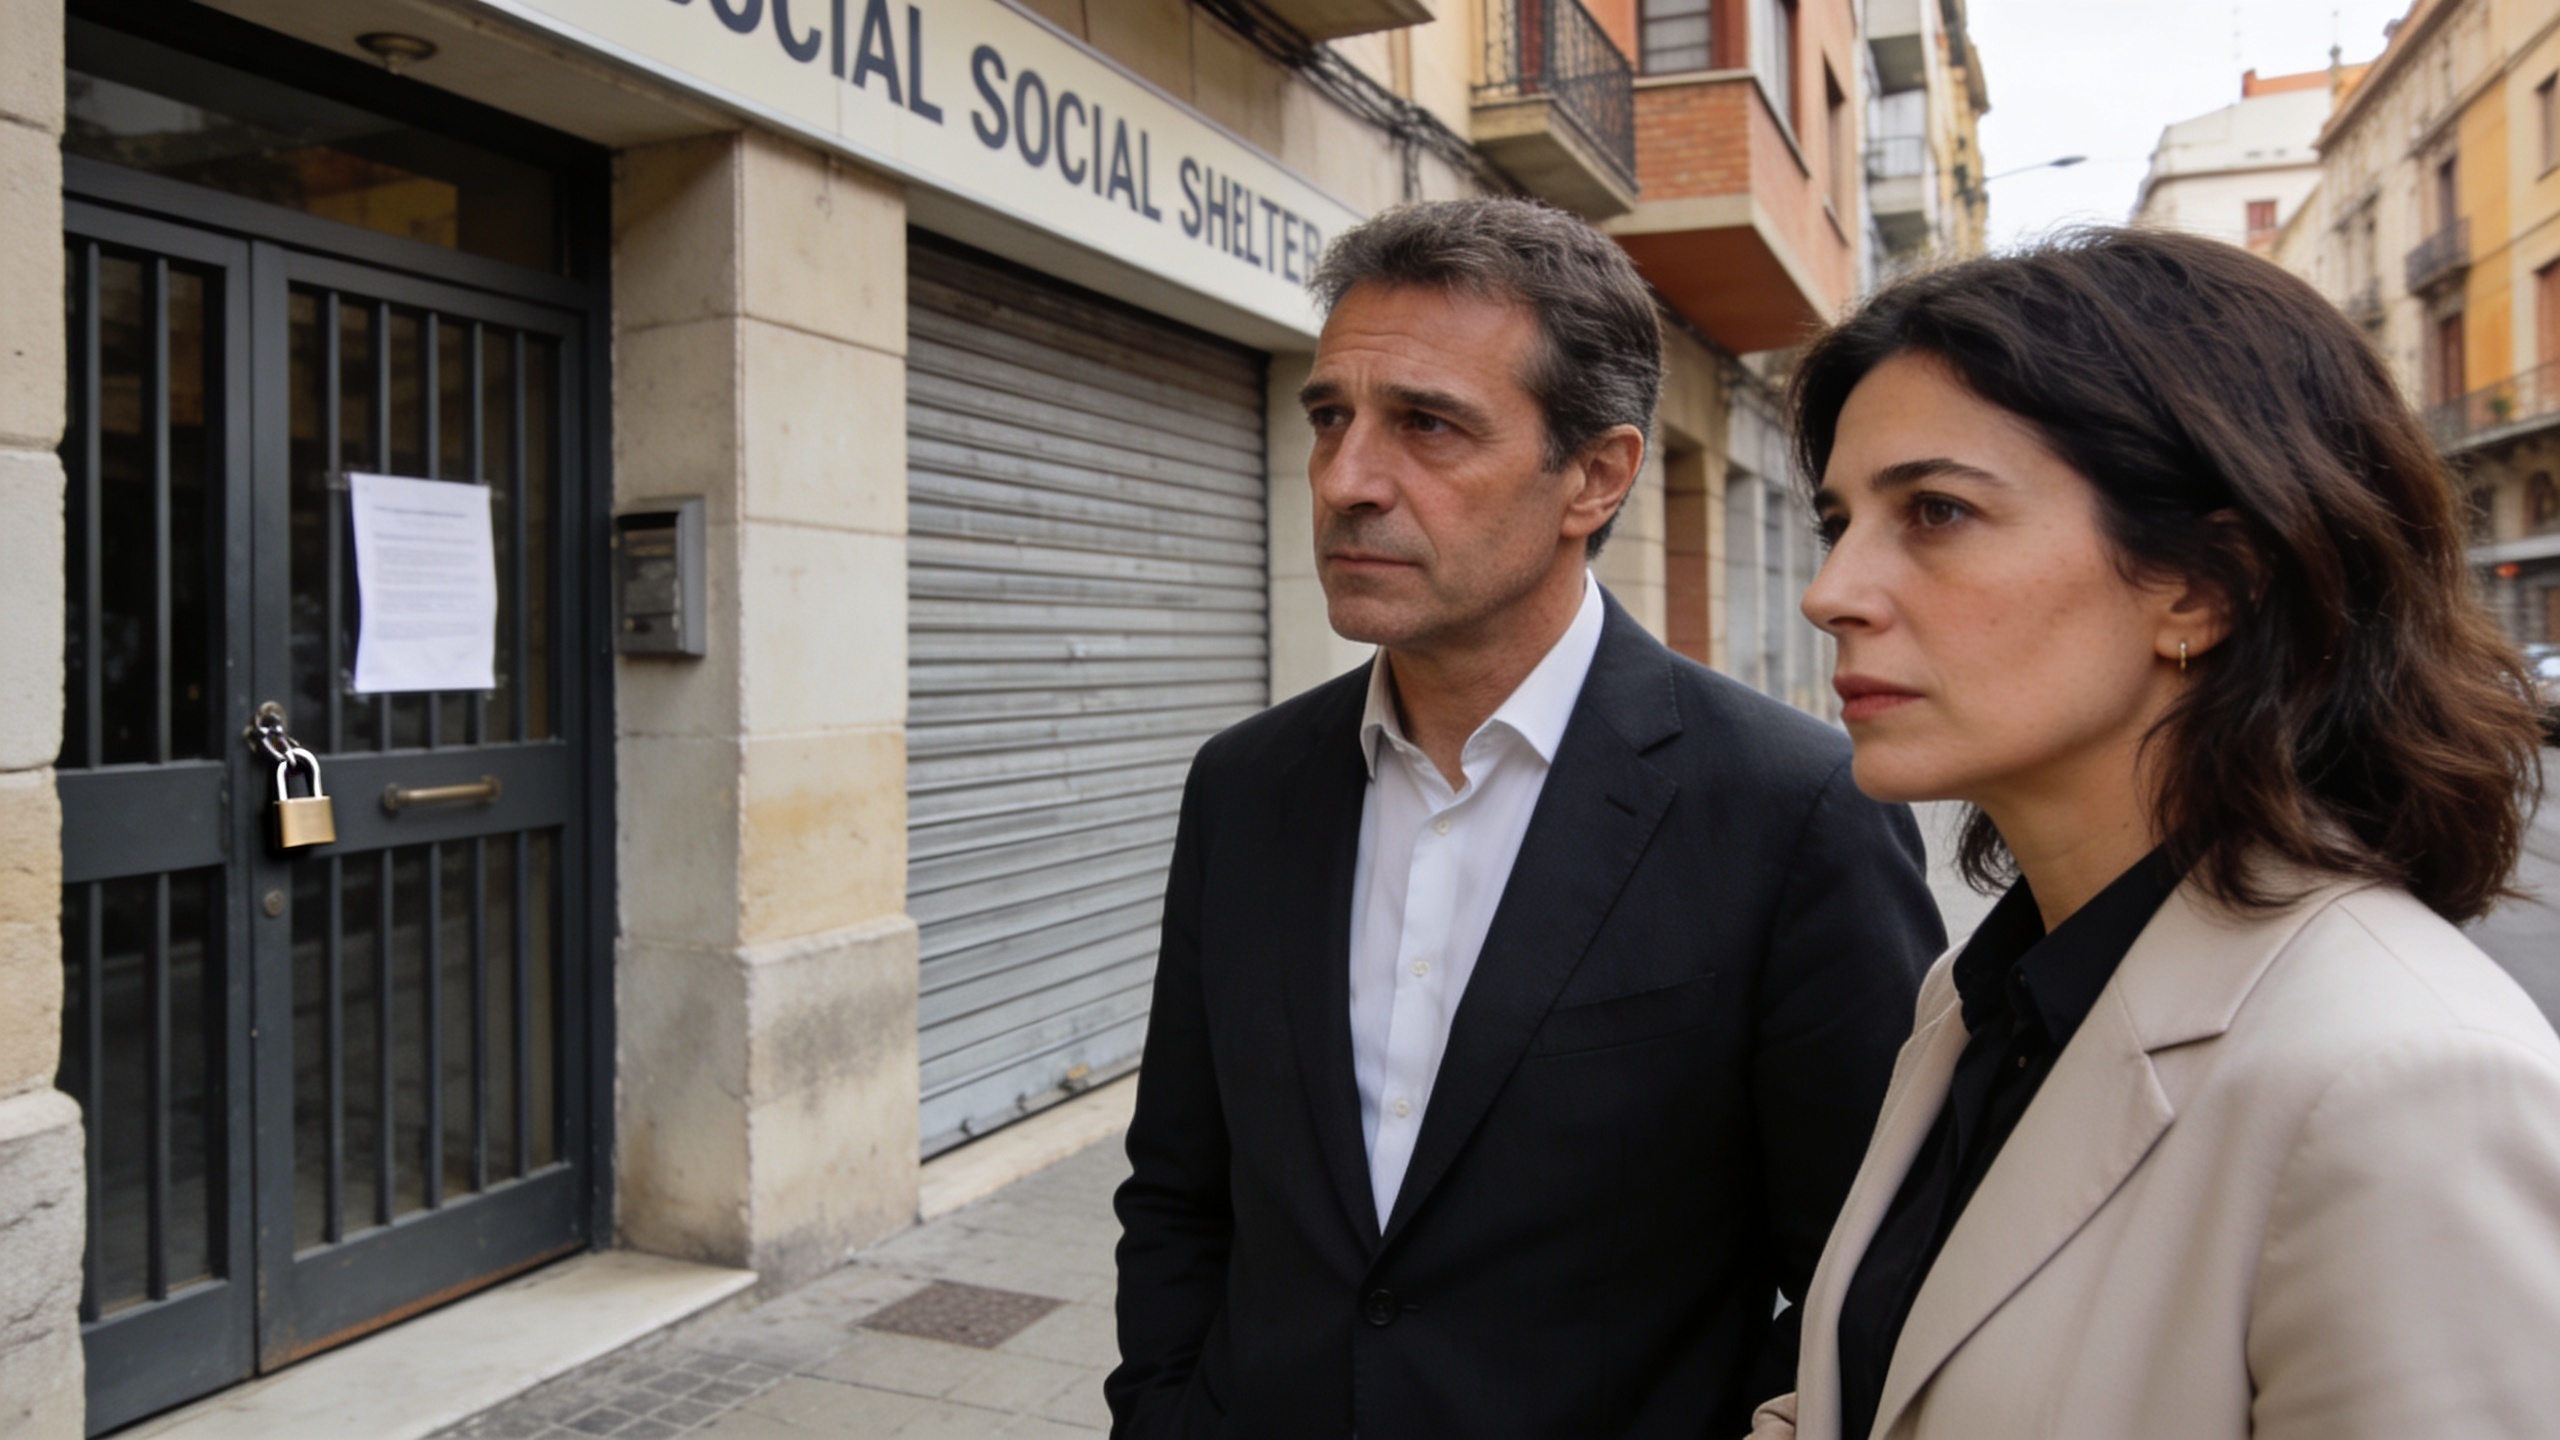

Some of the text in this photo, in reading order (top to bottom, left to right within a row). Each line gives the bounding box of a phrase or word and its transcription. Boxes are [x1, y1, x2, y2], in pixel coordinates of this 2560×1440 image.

[666, 0, 1322, 289] CIAL SOCIAL SHELTER
